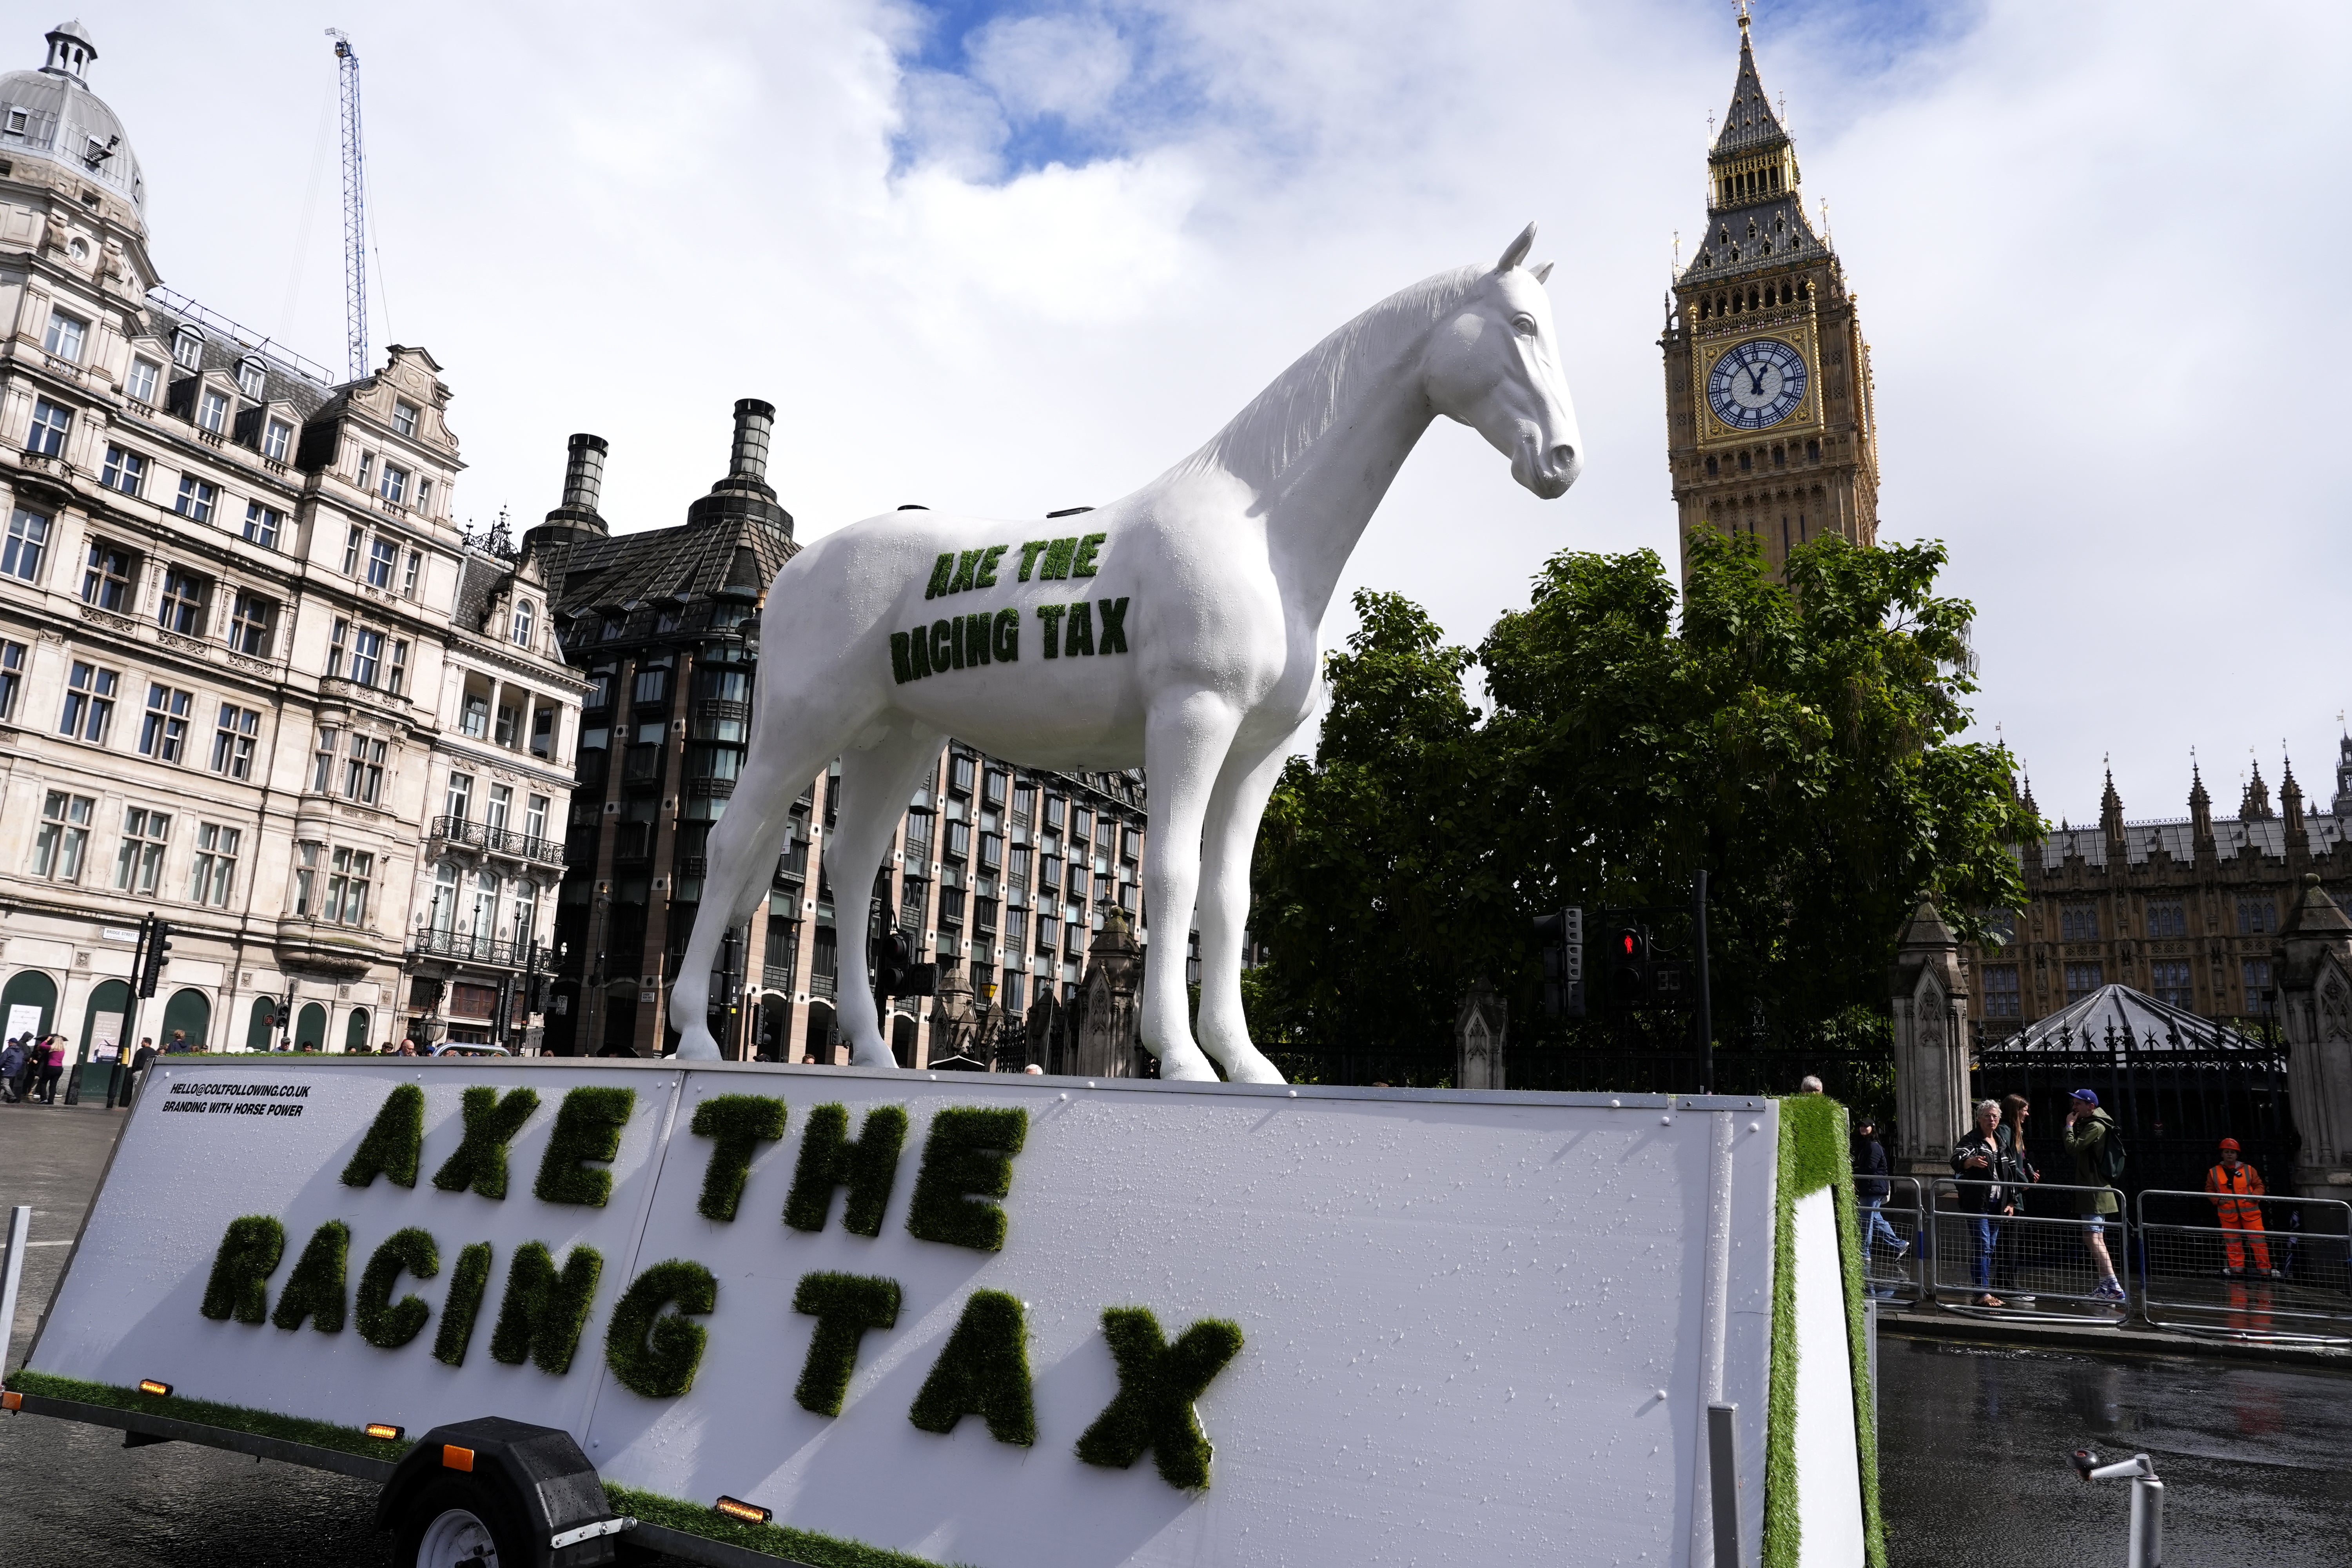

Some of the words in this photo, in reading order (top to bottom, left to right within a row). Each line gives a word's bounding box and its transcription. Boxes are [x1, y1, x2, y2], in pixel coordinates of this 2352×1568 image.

[925, 544, 1009, 600] AXE
[1018, 532, 1107, 583] THE
[890, 607, 1019, 685] RACING
[1037, 597, 1130, 659] TAX
[162, 1101, 208, 1113] BRANDING
[209, 1102, 234, 1114] WITH
[233, 1103, 267, 1116] HORSE
[267, 1104, 303, 1117] POWER
[170, 1083, 311, 1098] HELLO@COLTFOLLOWING.CO.UK
[340, 1082, 637, 1208] AXE
[690, 1091, 1029, 1252] THE
[200, 1213, 719, 1398] RACING
[791, 1269, 1245, 1493] TAX
